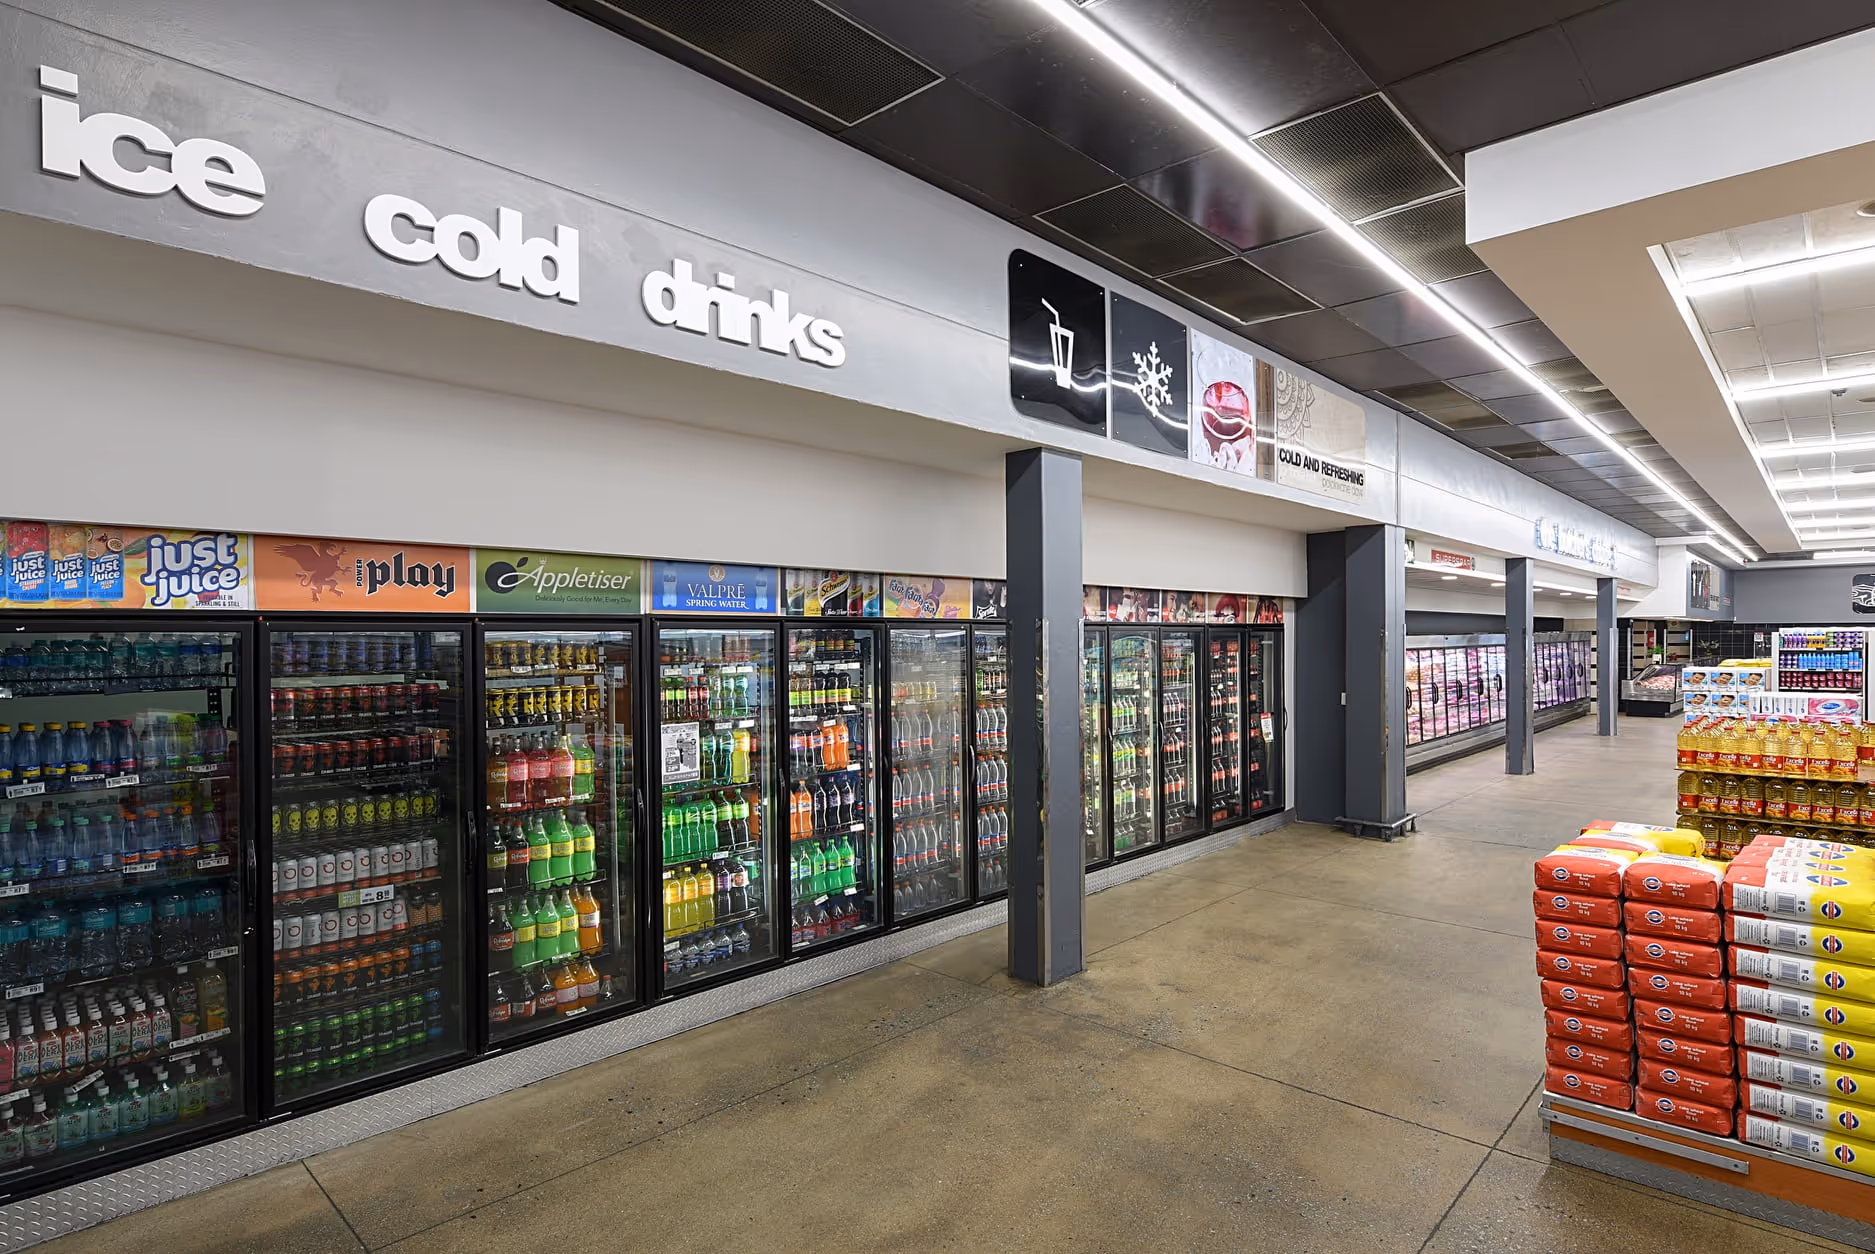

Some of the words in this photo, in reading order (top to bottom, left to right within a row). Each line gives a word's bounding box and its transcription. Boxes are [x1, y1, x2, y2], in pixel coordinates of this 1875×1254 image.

[39, 65, 266, 217] ice
[364, 193, 580, 304] cold
[641, 258, 847, 369] drinks
[1279, 448, 1302, 467] COLD
[1303, 455, 1320, 473] AND
[1321, 461, 1364, 487] REFRESHING
[11, 557, 45, 576] just
[53, 558, 82, 576] just
[143, 532, 236, 583] just
[14, 569, 46, 584] juice
[56, 570, 84, 584] juice
[90, 559, 120, 577] just
[93, 570, 121, 584] juice
[366, 551, 456, 599] play
[152, 566, 238, 606] juice
[497, 564, 633, 594] Appletiser
[685, 599, 717, 608] SPRING
[718, 600, 750, 610] WATER
